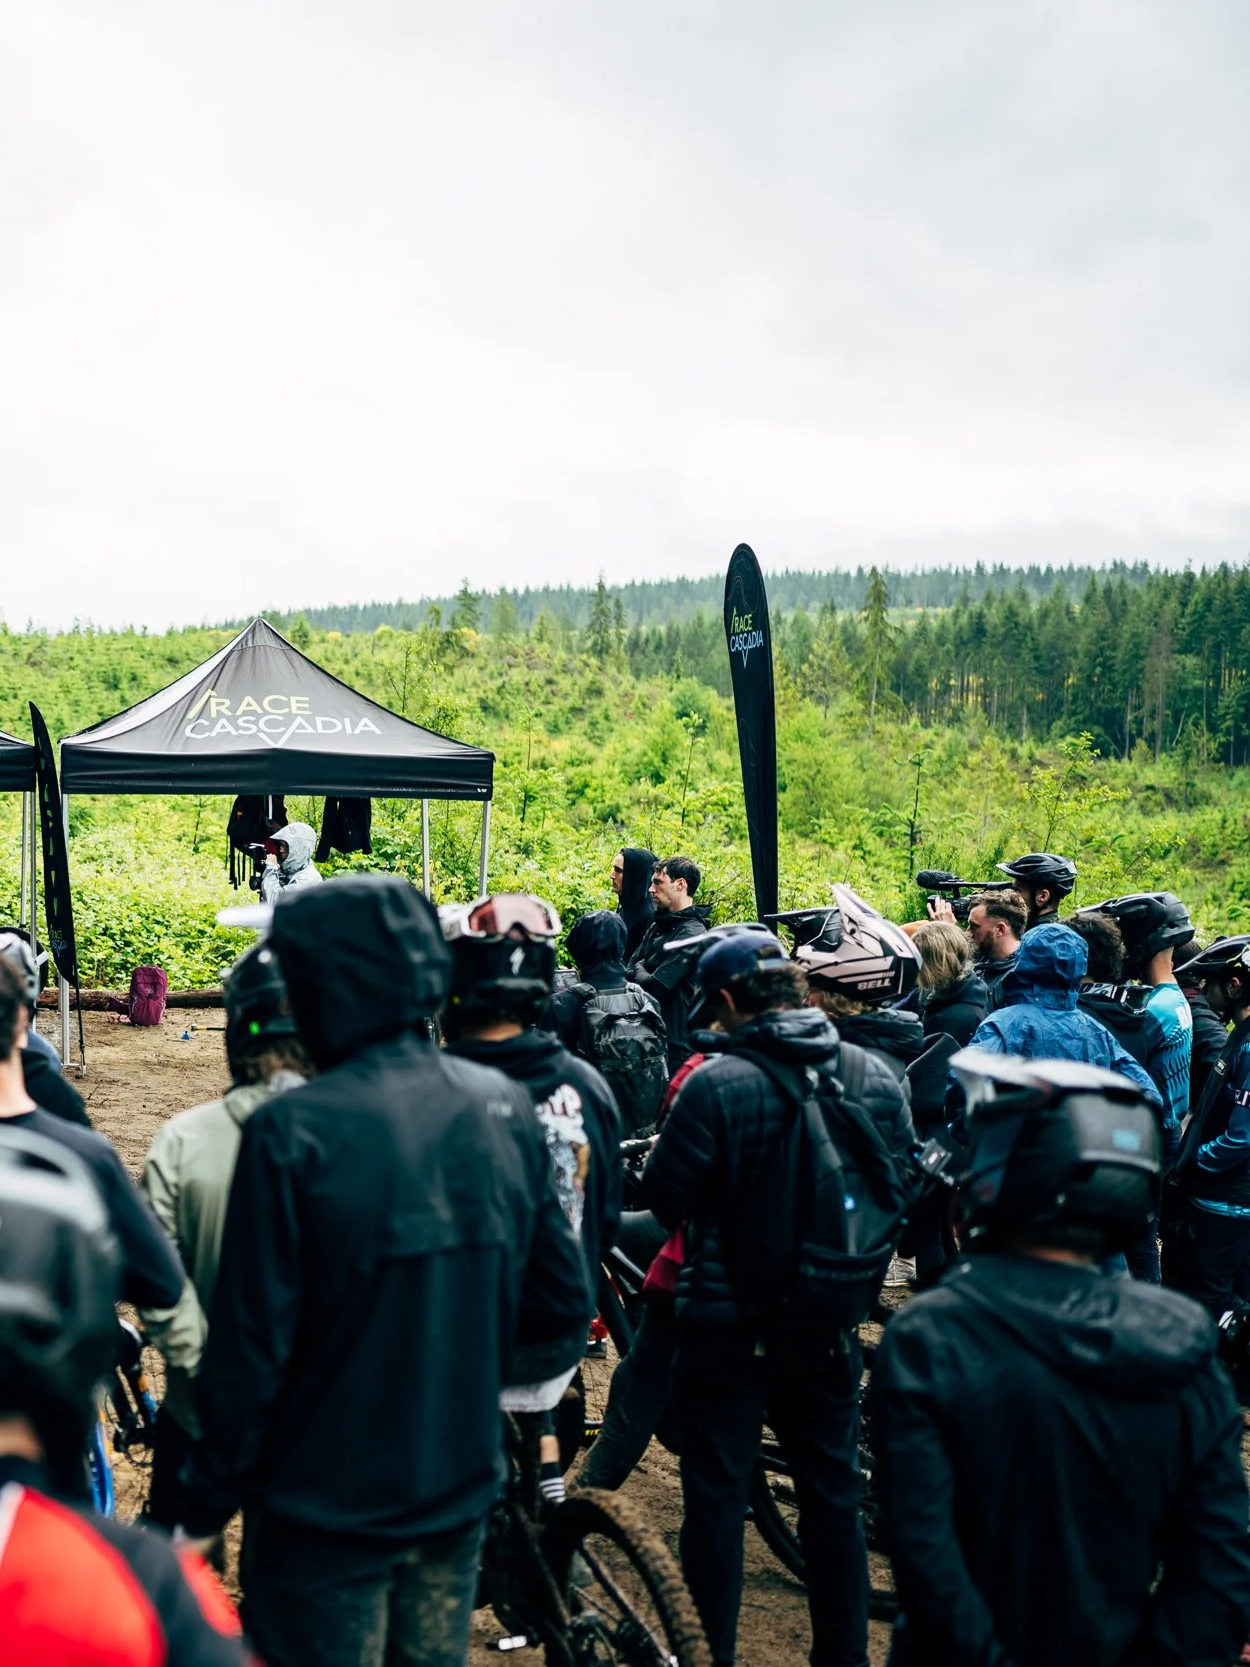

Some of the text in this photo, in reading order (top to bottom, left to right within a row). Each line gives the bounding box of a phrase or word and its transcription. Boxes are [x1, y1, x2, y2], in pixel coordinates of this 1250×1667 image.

[730, 606, 753, 634] RACE
[730, 630, 764, 668] CASCADIA
[186, 689, 312, 719] RACE
[184, 715, 383, 747] CASCADIA
[857, 978, 892, 991] BELL
